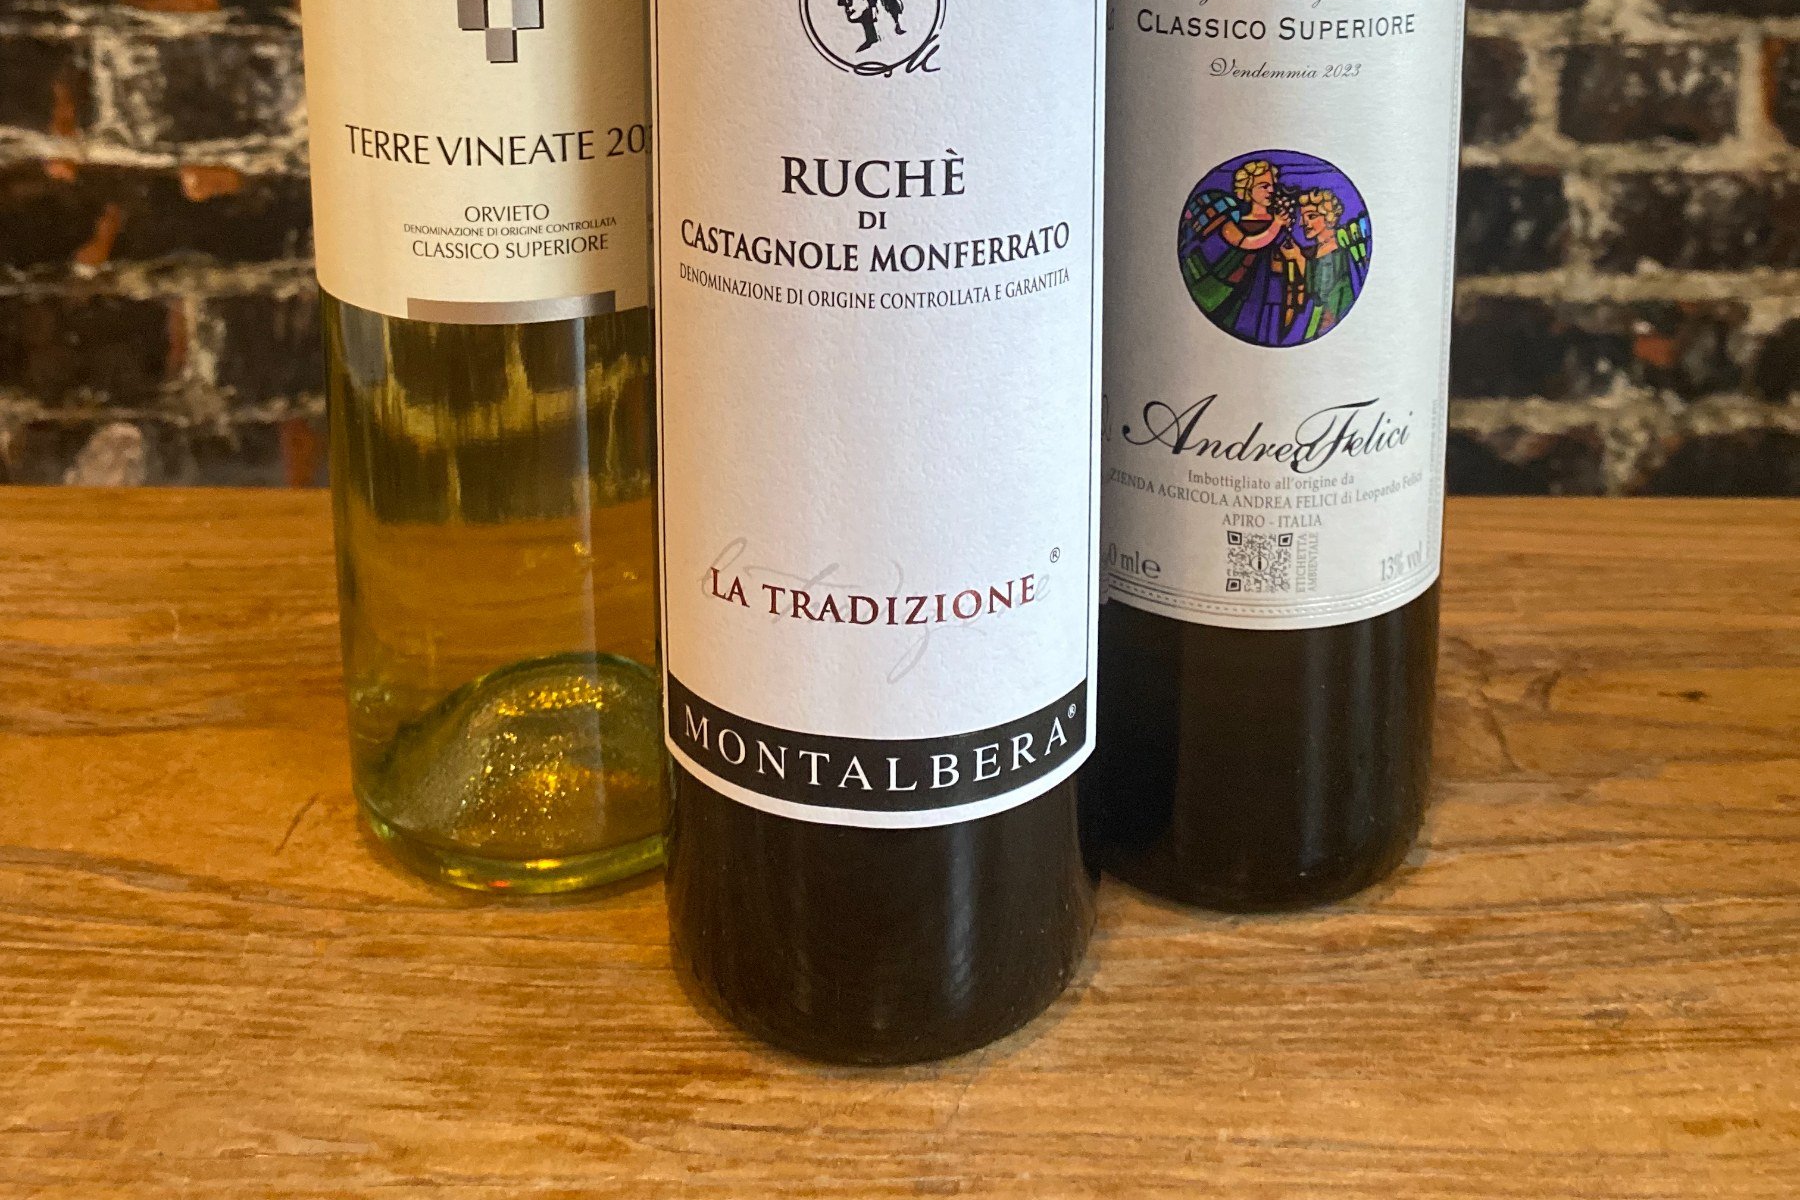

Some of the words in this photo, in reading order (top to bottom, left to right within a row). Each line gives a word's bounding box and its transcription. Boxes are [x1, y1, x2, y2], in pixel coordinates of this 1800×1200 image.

[1137, 8, 1266, 40] CLASSICO
[1278, 12, 1415, 40] SUPERIORE
[1209, 57, 1318, 79] Vendemmia
[1322, 63, 1362, 79] 2023
[345, 124, 430, 165] TERRE
[436, 130, 595, 166] VINEATE
[780, 148, 966, 199] RUCHÈ
[404, 223, 485, 237] DENOMINAZIONE
[487, 226, 498, 237] DI
[500, 224, 543, 236] ORIGINE
[545, 217, 617, 234] CONTROLLATA
[464, 203, 550, 223] ORVIETO
[858, 211, 887, 230] DI
[412, 240, 499, 260] CLASSICO
[506, 234, 609, 259] SUPERIORE
[681, 219, 859, 272] CASTAGNOLE
[870, 221, 1070, 272] MONFERRATO
[679, 262, 782, 303] DENOMINAZIONE
[787, 287, 804, 305] DI
[808, 289, 876, 310] ORIGINE
[880, 287, 991, 310] CONTROLLATA
[994, 284, 1002, 300] E
[1005, 267, 1070, 298] GARANTITA
[1121, 393, 1317, 463] Andrea
[1291, 397, 1413, 474] Felici
[1158, 483, 1228, 507] AGRICOLA
[1233, 495, 1292, 509] ANDREA
[1296, 493, 1338, 509] FELICI
[1341, 491, 1352, 505] di
[1355, 480, 1400, 504] Leopardo
[1188, 469, 1271, 492] Imbottigliato
[1341, 473, 1355, 486] da
[1222, 513, 1265, 528] APIRO
[1278, 513, 1323, 528] ITALIA
[710, 567, 750, 608] LA
[762, 573, 1035, 625] TRADIZIONE
